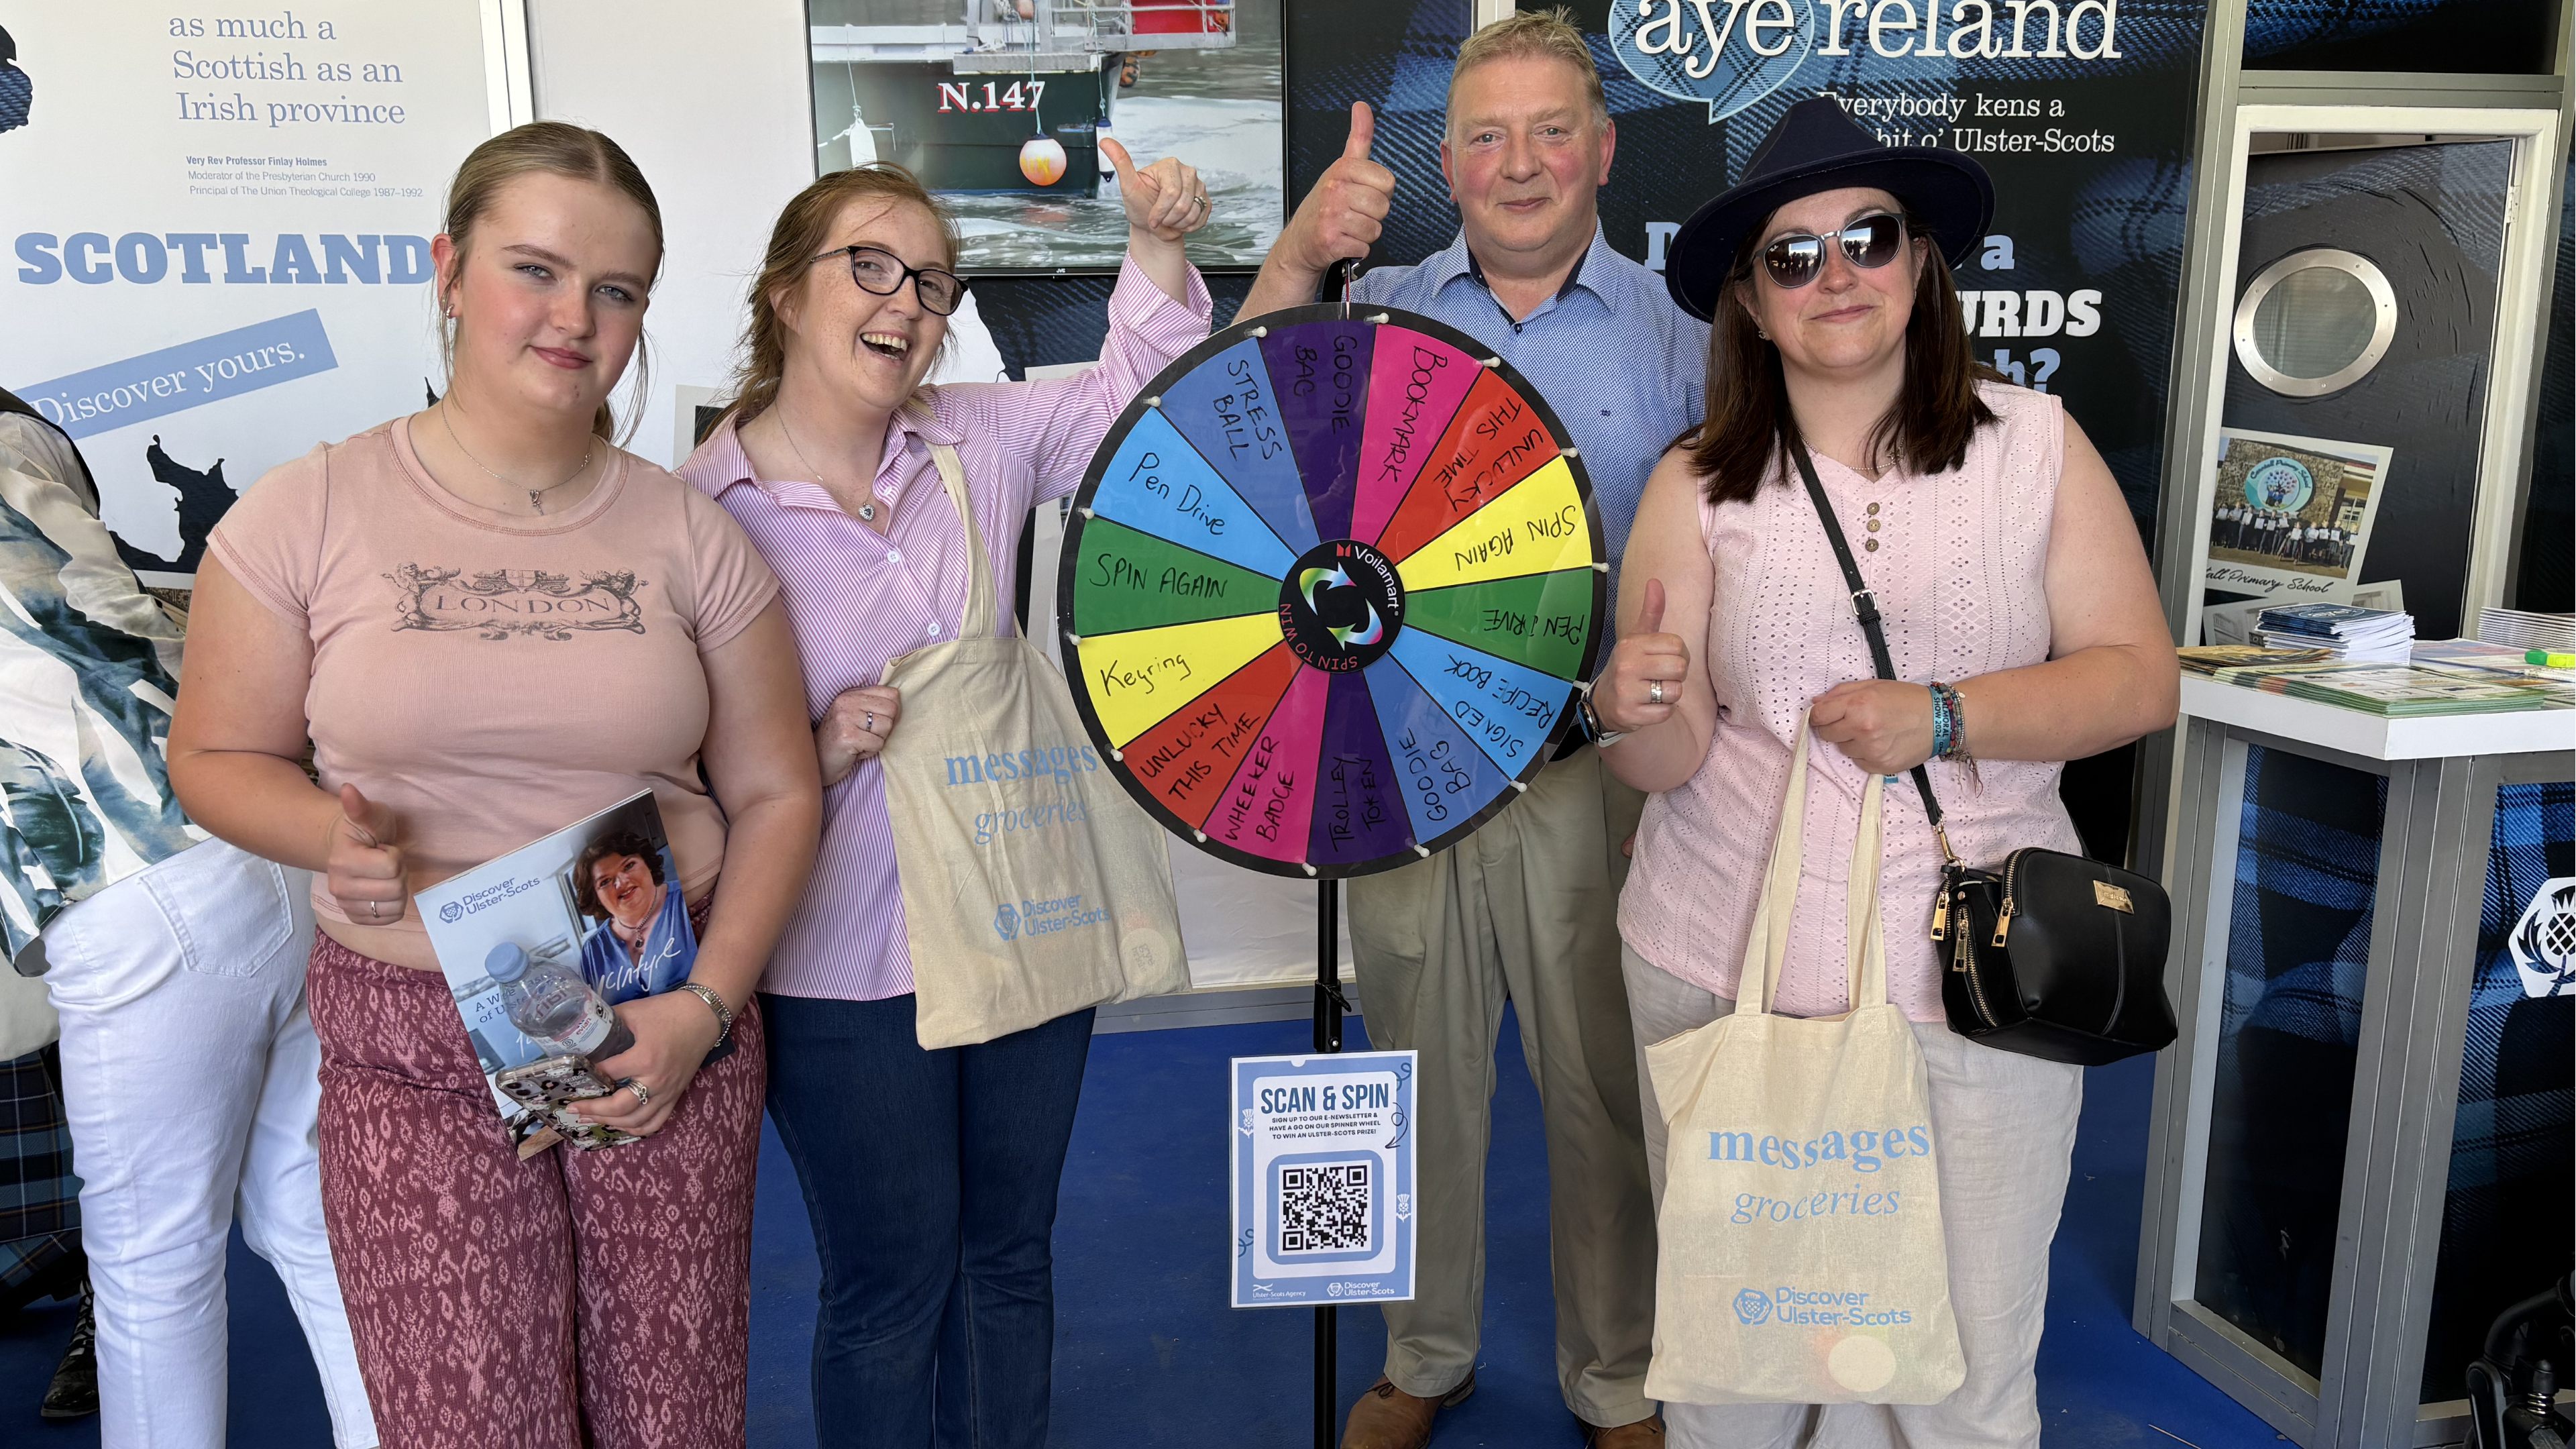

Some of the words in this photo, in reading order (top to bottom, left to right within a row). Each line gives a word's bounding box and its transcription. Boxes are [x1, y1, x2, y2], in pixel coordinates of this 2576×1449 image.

[169, 15, 204, 37] as
[216, 11, 308, 40] much
[318, 21, 336, 40] a
[172, 50, 307, 80] Scottish
[317, 62, 352, 82] as
[363, 62, 403, 83] an
[176, 93, 258, 121] Irish
[267, 95, 405, 127] province
[936, 80, 1045, 113] N.147
[1817, 91, 1967, 123] verybody
[1974, 93, 2041, 117] kens
[2049, 99, 2065, 117] a
[1952, 128, 2114, 153] Ulster-Scots
[186, 156, 205, 166] Very
[208, 156, 223, 165] Rev
[226, 156, 266, 166] Professor
[268, 157, 293, 167] Finlay
[296, 158, 327, 166] Holmes
[188, 171, 232, 180] Moderator
[235, 172, 243, 180] of
[246, 172, 260, 180] the
[262, 172, 316, 182] Presbyterian
[319, 172, 350, 181] Church
[354, 173, 375, 182] 1990
[190, 186, 227, 196] Principal
[230, 186, 238, 195] of
[241, 186, 258, 195] The
[261, 187, 286, 195] Union
[289, 187, 337, 197] Theological
[340, 187, 370, 197] College
[14, 232, 434, 284] SCOTLAND
[31, 371, 186, 427] Discover
[195, 341, 305, 393] yours.
[1294, 345, 1317, 397] BAG
[1332, 335, 1357, 434] GOODIE
[1213, 394, 1249, 462] BALL
[1228, 360, 1282, 460] STRESS
[1378, 345, 1448, 482] BOOKMARK
[1477, 398, 1521, 441] THIS
[1432, 447, 1479, 488] TIME
[1444, 429, 1544, 512] UNLUCKY
[1128, 452, 1169, 499] Pen
[1177, 484, 1225, 535] Drive
[1527, 505, 1576, 541] SPIN
[1455, 528, 1513, 571] AGAIN
[1089, 553, 1148, 590] SPIN
[1159, 568, 1228, 598] AGAIN
[2228, 570, 2284, 592] Primary
[2288, 578, 2334, 593] School
[436, 596, 610, 613] LONDON
[1280, 604, 1298, 642] WIN
[1543, 614, 1585, 645] PEN
[1295, 643, 1313, 663] TO
[1318, 655, 1358, 670] SPIN
[1100, 655, 1191, 696] Keyring
[1444, 654, 1492, 689] BOOK
[1140, 703, 1228, 778] UNLUCKY
[1456, 701, 1523, 757] SIGNED
[944, 744, 1097, 786] messages
[1168, 760, 1212, 800] THIS
[1212, 712, 1260, 757] TIME
[1399, 727, 1448, 820] GOODIE
[1430, 741, 1470, 794] BAG
[1256, 771, 1295, 843] BADGE
[1329, 757, 1360, 852] TROLLEY
[1361, 758, 1386, 831] TOKEN
[975, 796, 1087, 845] groceries
[462, 877, 515, 906] Discover
[466, 877, 540, 914] Ulster-Scots
[1022, 895, 1082, 918] Discover
[1024, 907, 1111, 937] Ulster-Scots
[476, 1002, 486, 1013] A
[480, 1013, 492, 1023] of
[576, 1018, 592, 1035] evian
[1261, 1087, 1316, 1114] SCAN
[1323, 1085, 1336, 1111] &
[1342, 1083, 1389, 1110] SPIN
[1308, 1130, 1356, 1138] ULSTER-SCOTS
[1324, 1113, 1372, 1121] E-NEWSLETTER
[1708, 1125, 1930, 1173] messages
[1731, 1183, 1900, 1224] groceries
[1344, 1288, 1395, 1296] Ulster-Scots
[1775, 1286, 1870, 1306] Discover
[1776, 1305, 1912, 1326] Ulster-Scots
